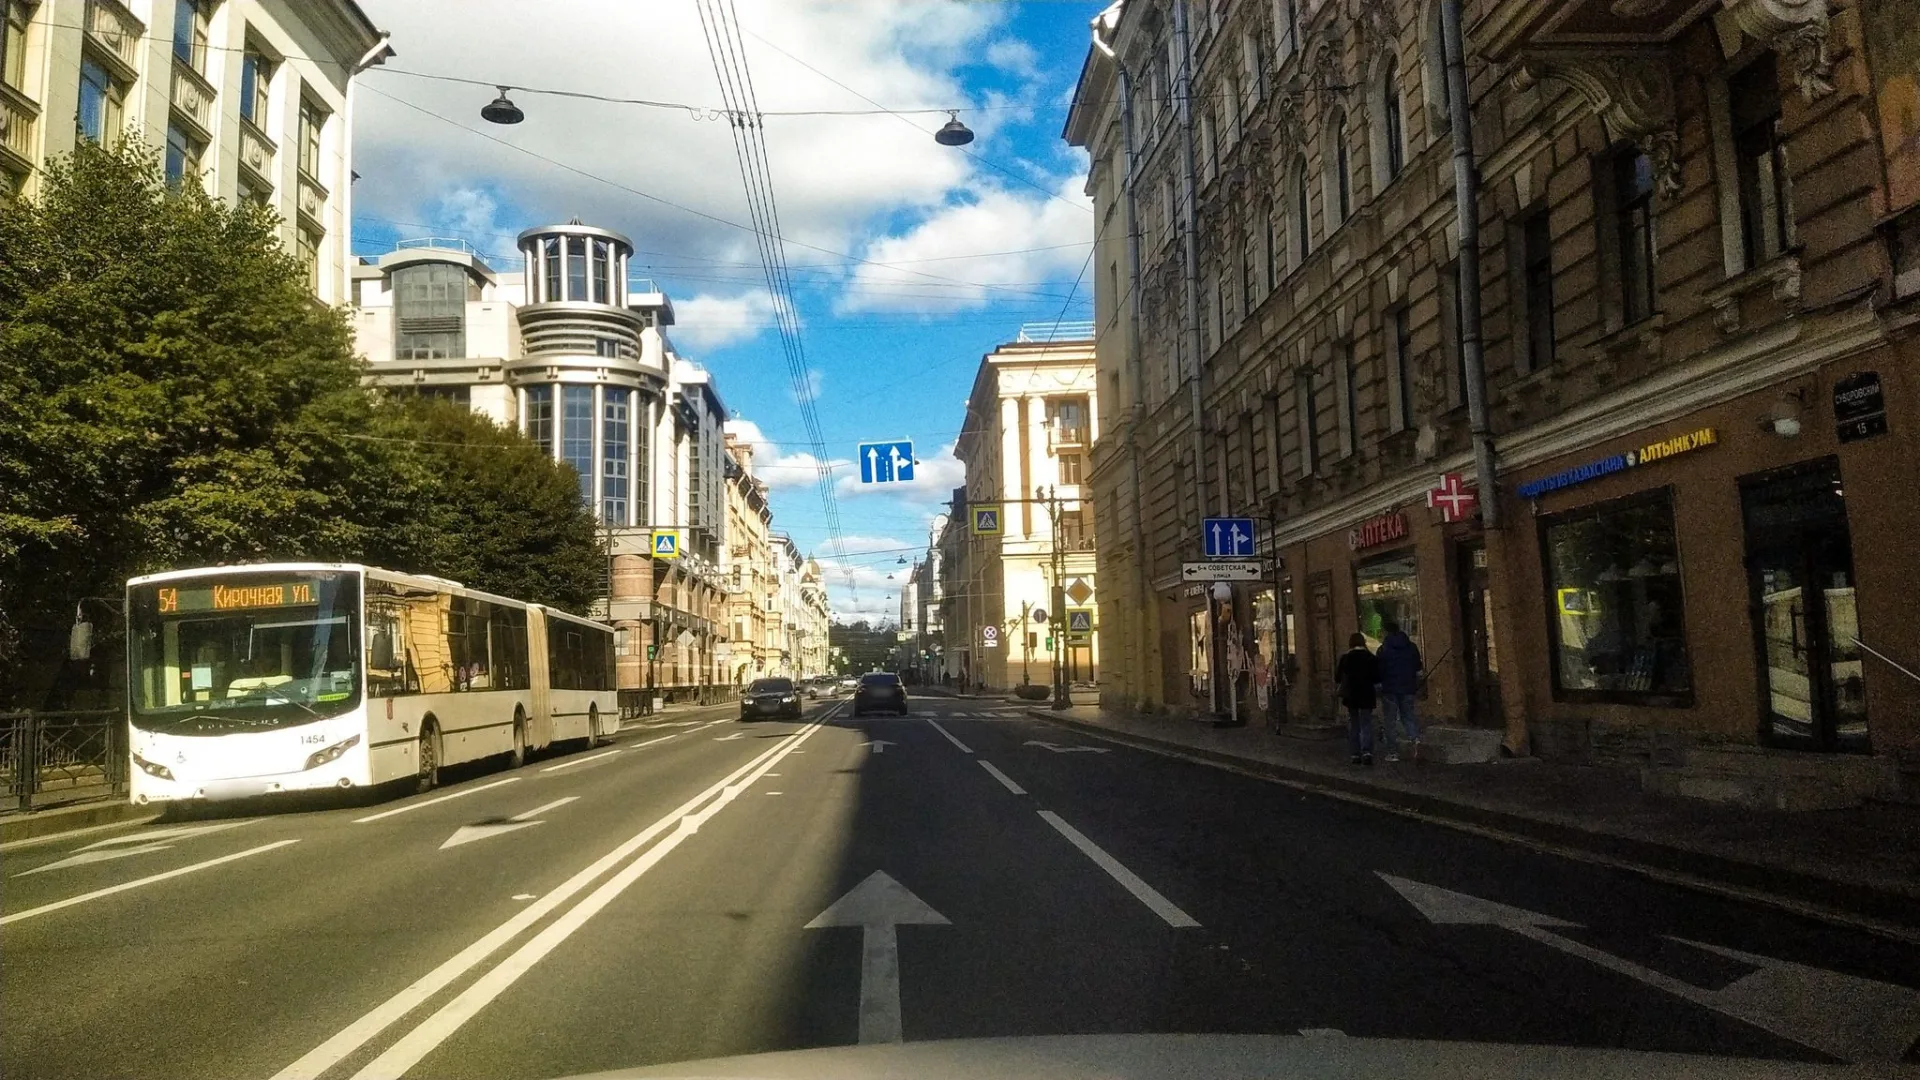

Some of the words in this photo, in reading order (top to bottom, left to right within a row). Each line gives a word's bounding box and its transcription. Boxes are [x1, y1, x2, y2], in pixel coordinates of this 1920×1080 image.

[1857, 422, 1867, 435] 15
[1639, 428, 1711, 464] АЛТЫНКУМ
[1557, 472, 1568, 488] ИЗ
[1569, 454, 1625, 484] КАЗАХСТАНА
[1358, 513, 1404, 548] АПТЕКА
[158, 588, 177, 612] 54
[213, 585, 283, 609] Кирочная
[292, 585, 316, 603] ул.
[300, 734, 326, 745] 1454
